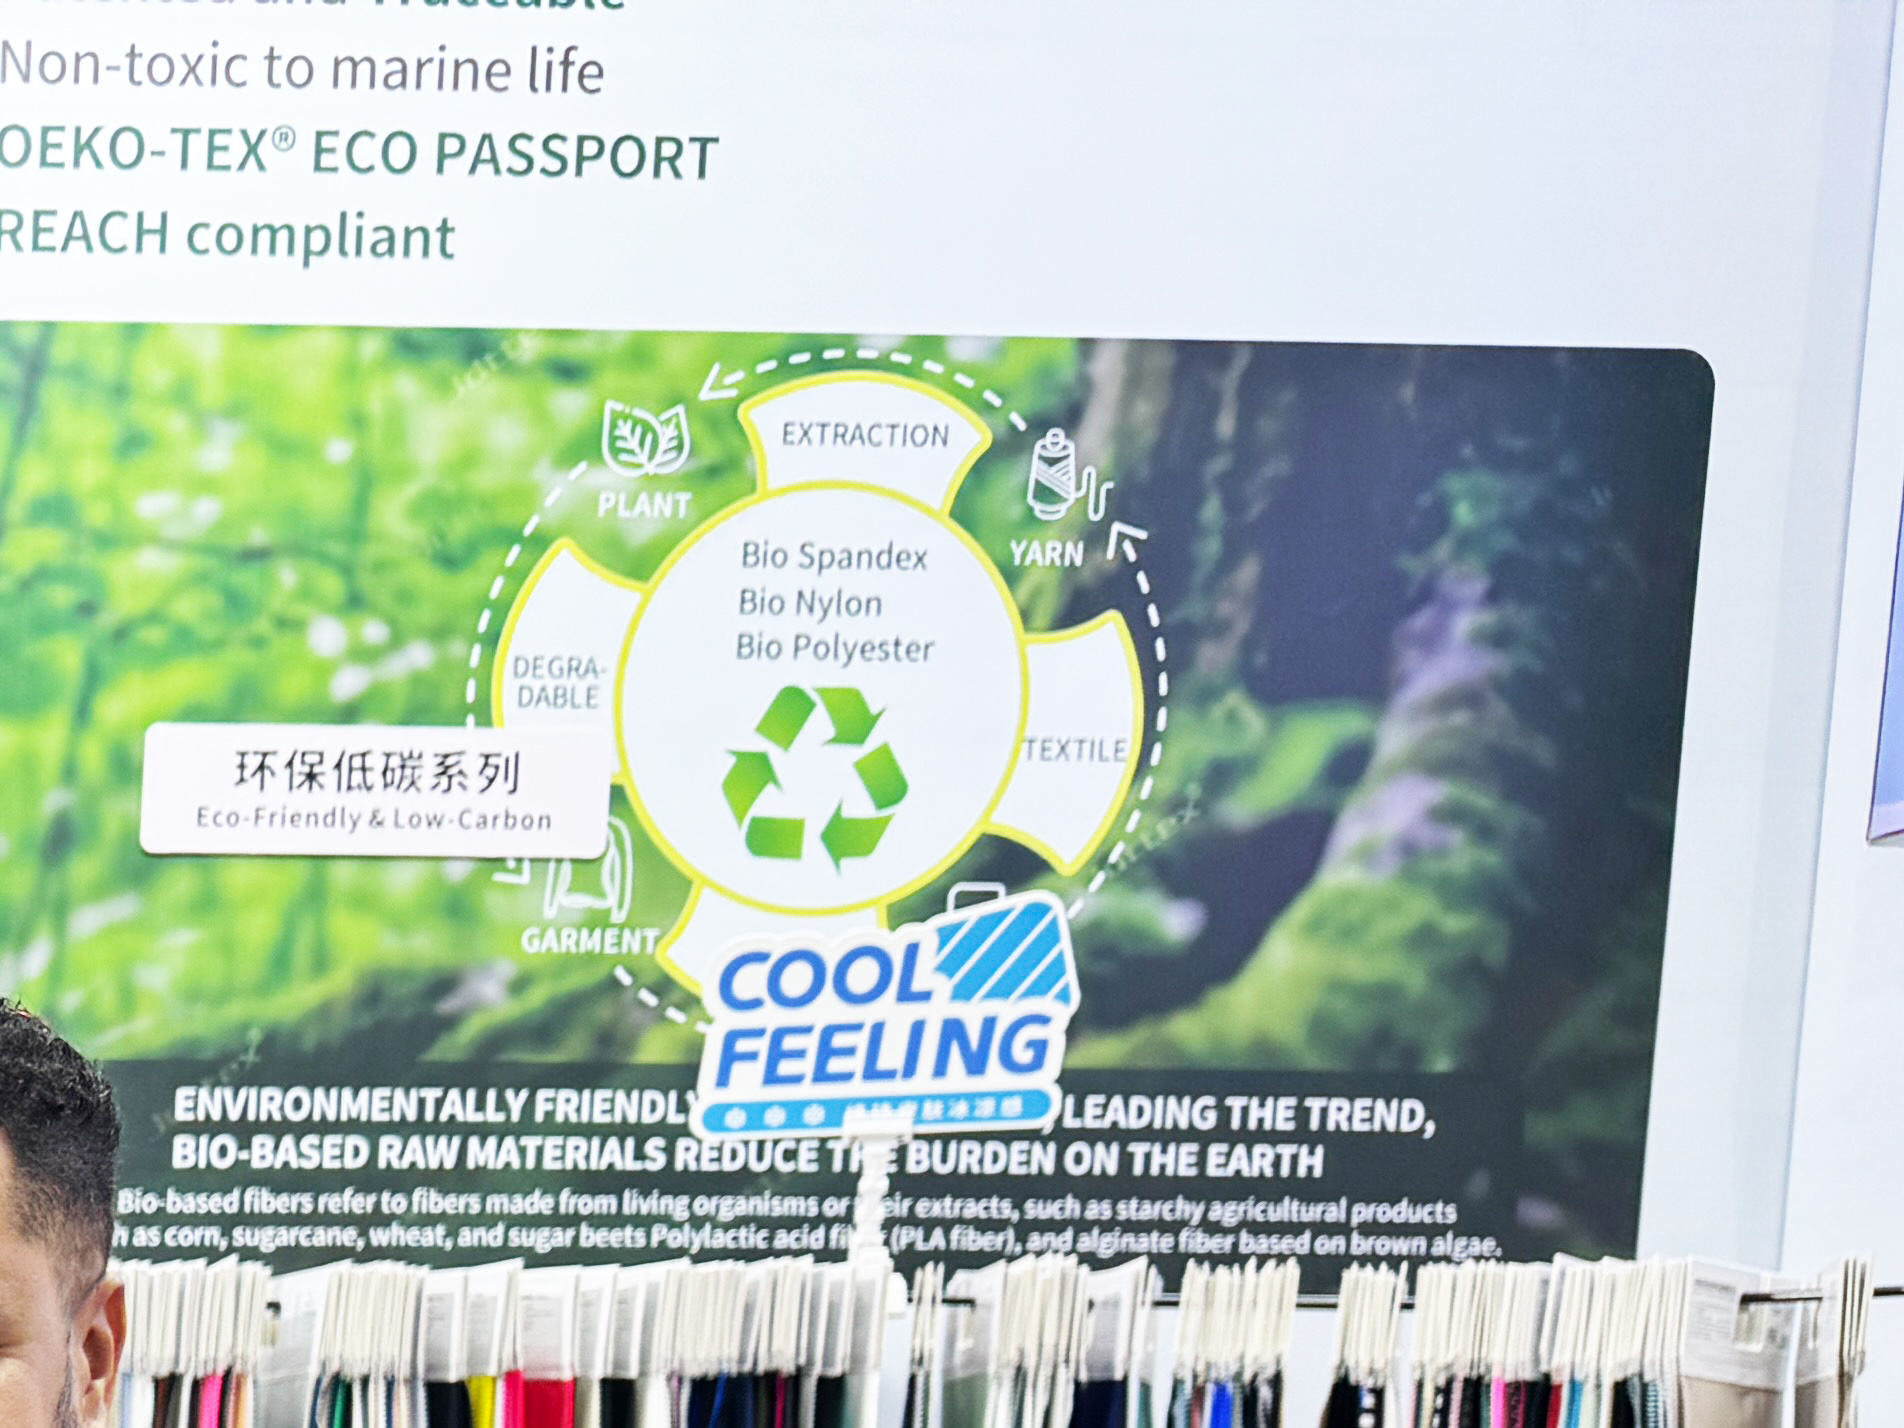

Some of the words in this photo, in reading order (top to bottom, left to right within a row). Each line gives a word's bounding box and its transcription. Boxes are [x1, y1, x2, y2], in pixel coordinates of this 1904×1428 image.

[0, 40, 249, 90] Non-toxic
[264, 48, 313, 89] to
[331, 48, 511, 93] marine
[528, 46, 605, 95] life
[312, 130, 418, 176] ECO
[436, 131, 719, 181] PASSPORT
[187, 213, 455, 269] compliant
[782, 422, 949, 448] EXTRACTION
[597, 491, 691, 519] PLANT
[742, 542, 786, 569] Bio
[797, 542, 928, 576] Spandex
[1010, 540, 1084, 567] YARN
[739, 590, 785, 616] Bio
[795, 590, 882, 623] Nylon
[514, 655, 608, 679] DEGRA-
[736, 633, 782, 660] Bio
[793, 635, 934, 669] Polyester
[518, 685, 599, 709] DABLE
[1023, 739, 1127, 763] TEXTILE
[234, 749, 520, 795] 环保低碳系列
[196, 806, 362, 832] Eco-Friendly
[369, 809, 385, 830] &
[393, 807, 552, 832] Low-Carbon
[521, 927, 657, 955] GARMENT
[718, 942, 935, 1011] COOL
[715, 1014, 1053, 1088] FEELING
[174, 1087, 524, 1123] ENVIRONMENTALLY
[534, 1090, 700, 1123] FRIENDLY
[1063, 1095, 1216, 1131] LEADING
[1225, 1097, 1297, 1131] THE
[1305, 1097, 1436, 1139] TREND,
[172, 1135, 369, 1170] BIO-BASED
[378, 1136, 467, 1170] RAW
[474, 1136, 666, 1171] MATERIALS
[675, 1140, 819, 1172] REDUCE
[906, 1140, 1056, 1175] BURDEN
[1064, 1143, 1117, 1175] ON
[1127, 1144, 1197, 1176] THE
[1205, 1144, 1323, 1178] EARTH
[118, 1189, 239, 1215] Bio-based
[244, 1189, 314, 1215] fibers
[319, 1190, 376, 1215] refer
[381, 1193, 407, 1215] to
[412, 1190, 480, 1215] fibers
[486, 1190, 554, 1216] made
[559, 1190, 615, 1216] from
[623, 1190, 689, 1222] living
[693, 1191, 818, 1221] organisms
[915, 1195, 1020, 1224] extracts,
[1023, 1195, 1079, 1222] such
[1116, 1197, 1203, 1229] starchy
[1207, 1196, 1346, 1228] agricultural
[1351, 1198, 1456, 1228] products
[164, 1228, 227, 1252] corn,
[233, 1226, 365, 1253] sugarcane,
[369, 1223, 453, 1252] wheat,
[458, 1223, 505, 1249] and
[510, 1229, 574, 1254] sugar
[579, 1223, 646, 1250] beets
[652, 1223, 770, 1254] Polylactic
[774, 1224, 825, 1250] acid
[892, 1226, 945, 1253] (PLA
[950, 1226, 1021, 1256] fiber),
[1029, 1226, 1073, 1253] and
[1078, 1227, 1174, 1259] alginate
[1180, 1228, 1234, 1254] fiber
[1238, 1228, 1309, 1255] based
[1350, 1229, 1427, 1256] brown
[1431, 1229, 1502, 1261] algae.
